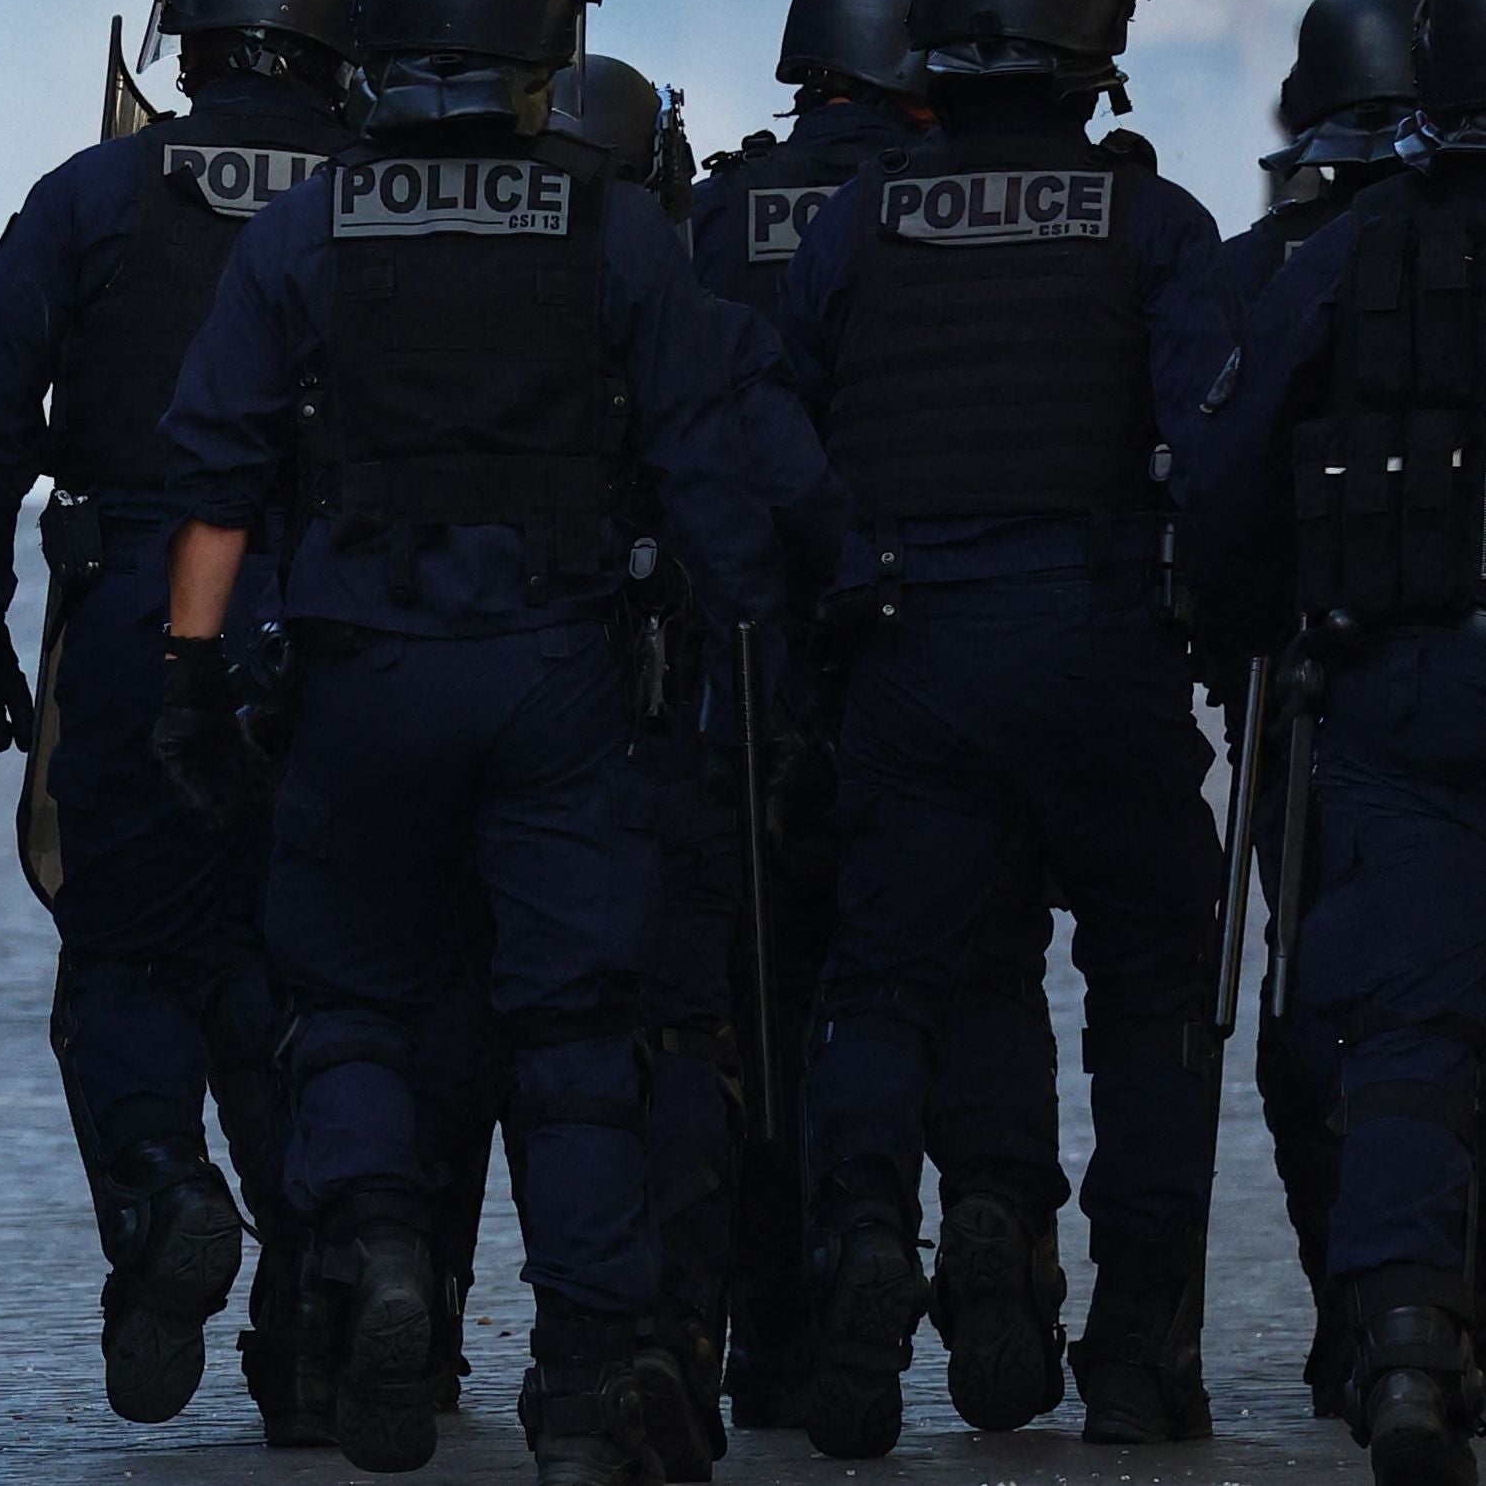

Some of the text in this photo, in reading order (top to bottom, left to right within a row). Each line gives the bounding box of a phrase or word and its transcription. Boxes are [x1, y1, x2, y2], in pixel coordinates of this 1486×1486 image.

[171, 149, 336, 202] POLI
[341, 163, 564, 214] POLICE
[508, 215, 560, 230] CSI 13
[886, 175, 1106, 232] POLICE
[1039, 223, 1100, 236] CSI 13
